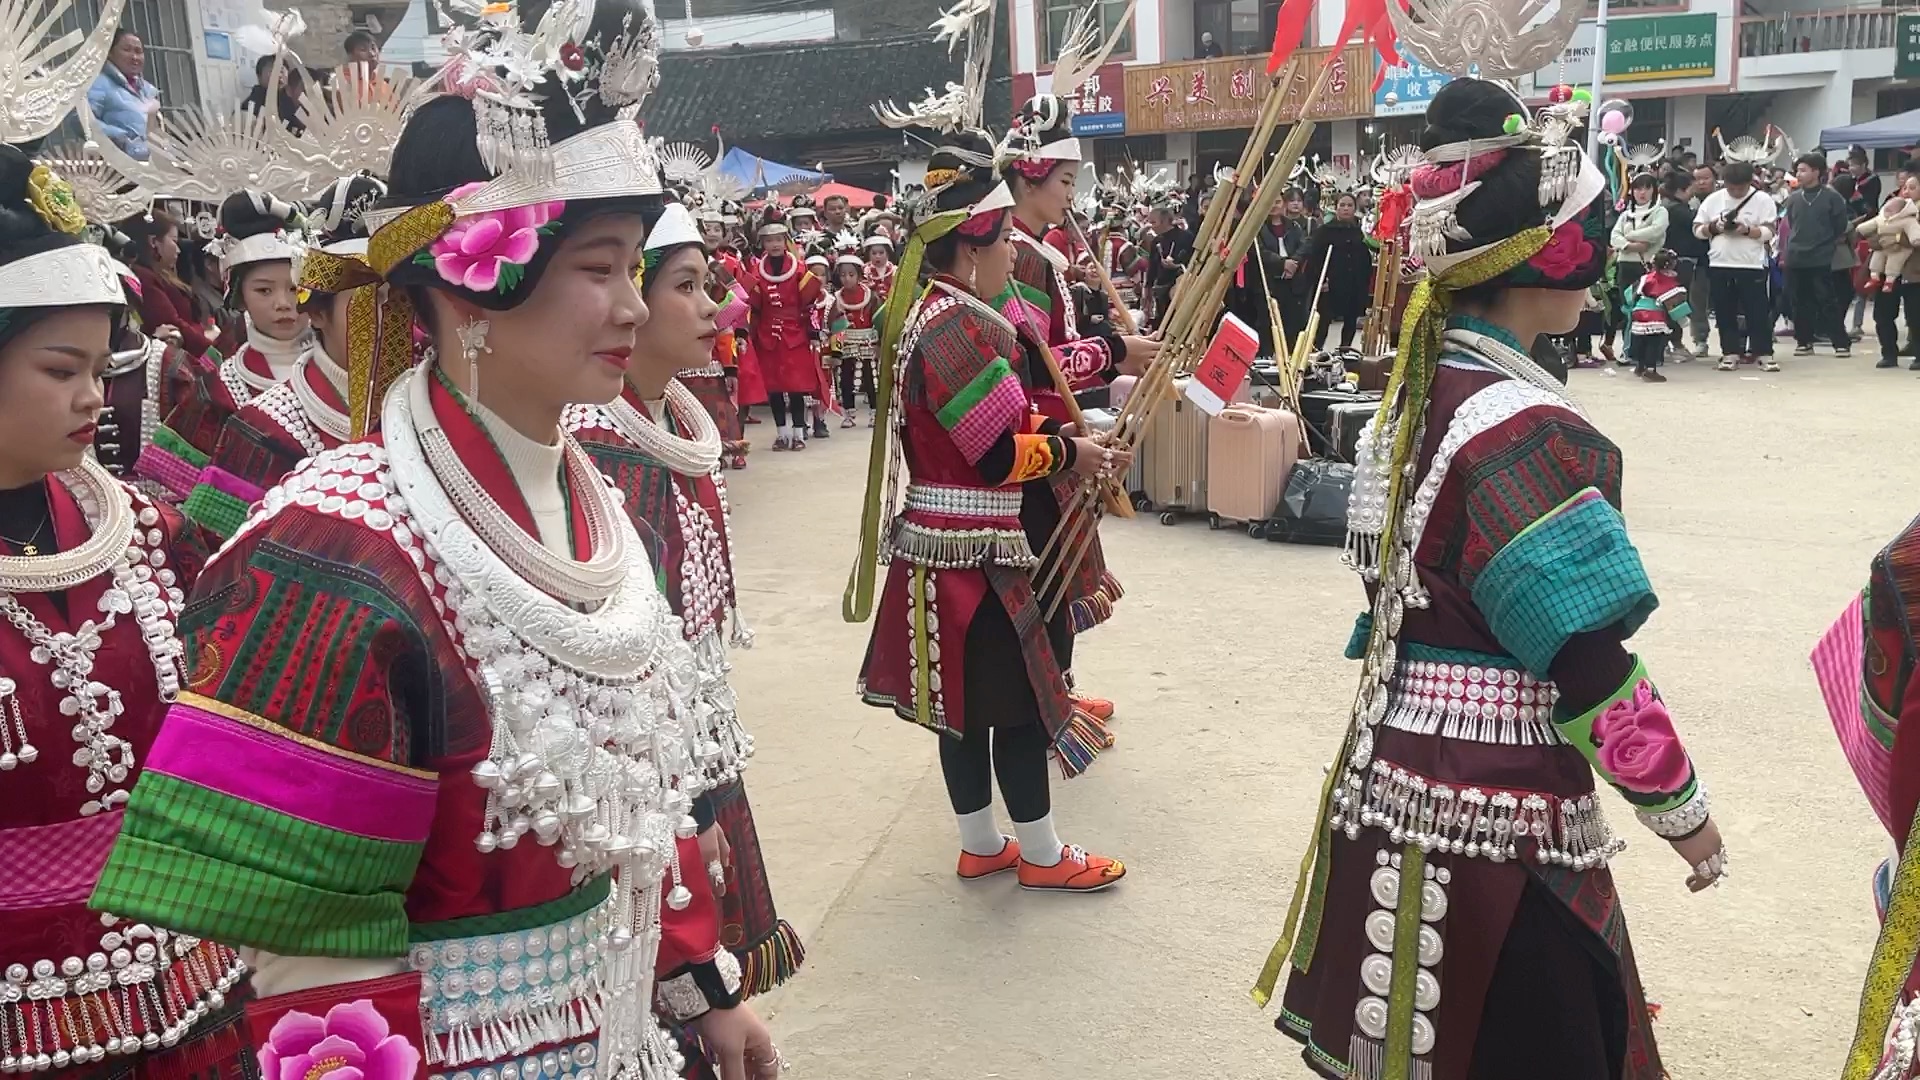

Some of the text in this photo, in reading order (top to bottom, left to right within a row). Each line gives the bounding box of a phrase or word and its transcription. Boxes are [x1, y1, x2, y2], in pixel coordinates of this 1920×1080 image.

[1609, 32, 1713, 54] 金融便民服务点
[1145, 57, 1349, 107] 兴美副店
